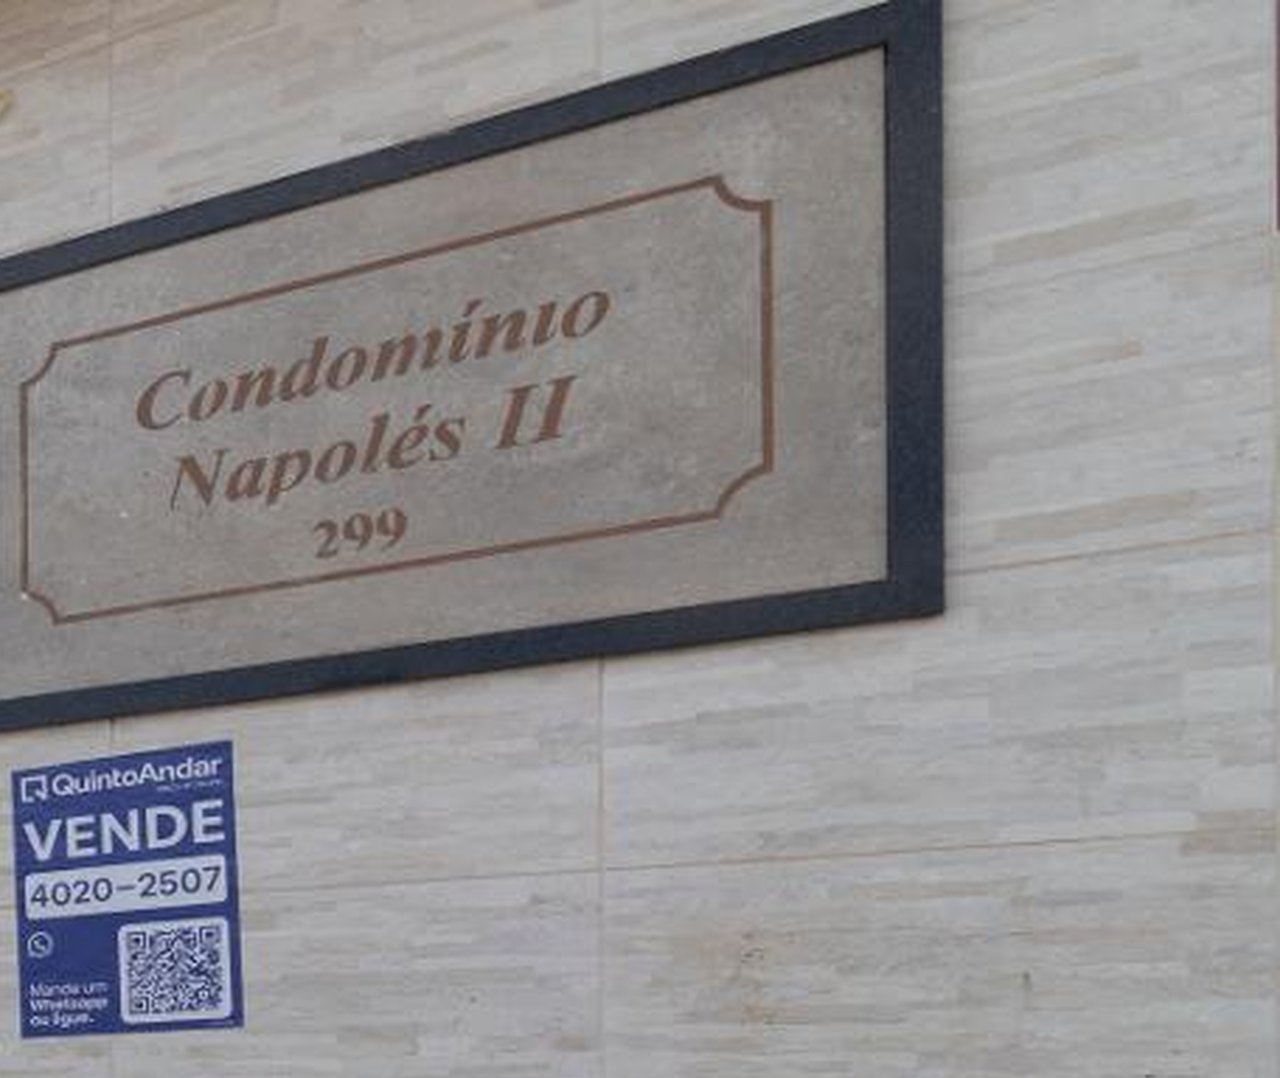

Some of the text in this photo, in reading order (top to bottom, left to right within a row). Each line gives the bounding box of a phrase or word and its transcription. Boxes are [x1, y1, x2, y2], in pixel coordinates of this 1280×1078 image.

[135, 291, 611, 430] Condomínio
[169, 375, 578, 511] Napolés II
[312, 507, 408, 559] 299
[52, 757, 223, 796] QuintoAndar
[23, 800, 226, 861] VENDE
[30, 866, 222, 908] 4020-2507
